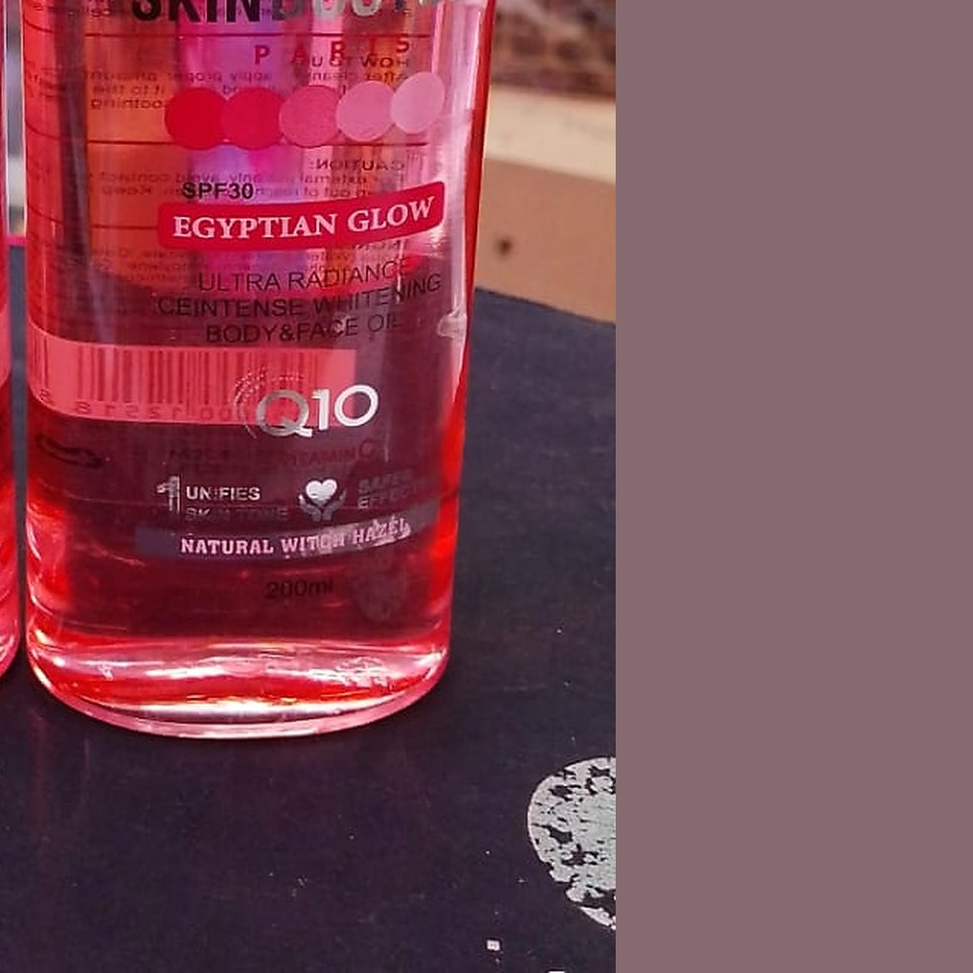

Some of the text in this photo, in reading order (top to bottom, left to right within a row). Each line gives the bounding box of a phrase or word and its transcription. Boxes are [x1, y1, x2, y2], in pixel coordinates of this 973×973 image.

[254, 39, 410, 66] PARIS
[181, 181, 255, 201] SPF30
[171, 195, 436, 241] EGYPTIAN GLOW
[197, 271, 282, 293] ULTRA
[288, 255, 415, 291] RADIANCE
[157, 273, 443, 319] CEINTENSE WHITENING
[205, 314, 402, 346] BODY&FACE OIL
[255, 383, 380, 439] Q10
[185, 485, 262, 502] UNIFIES
[180, 514, 412, 556] NATURAL WITCH HAZEL
[265, 576, 334, 601] 200ml
